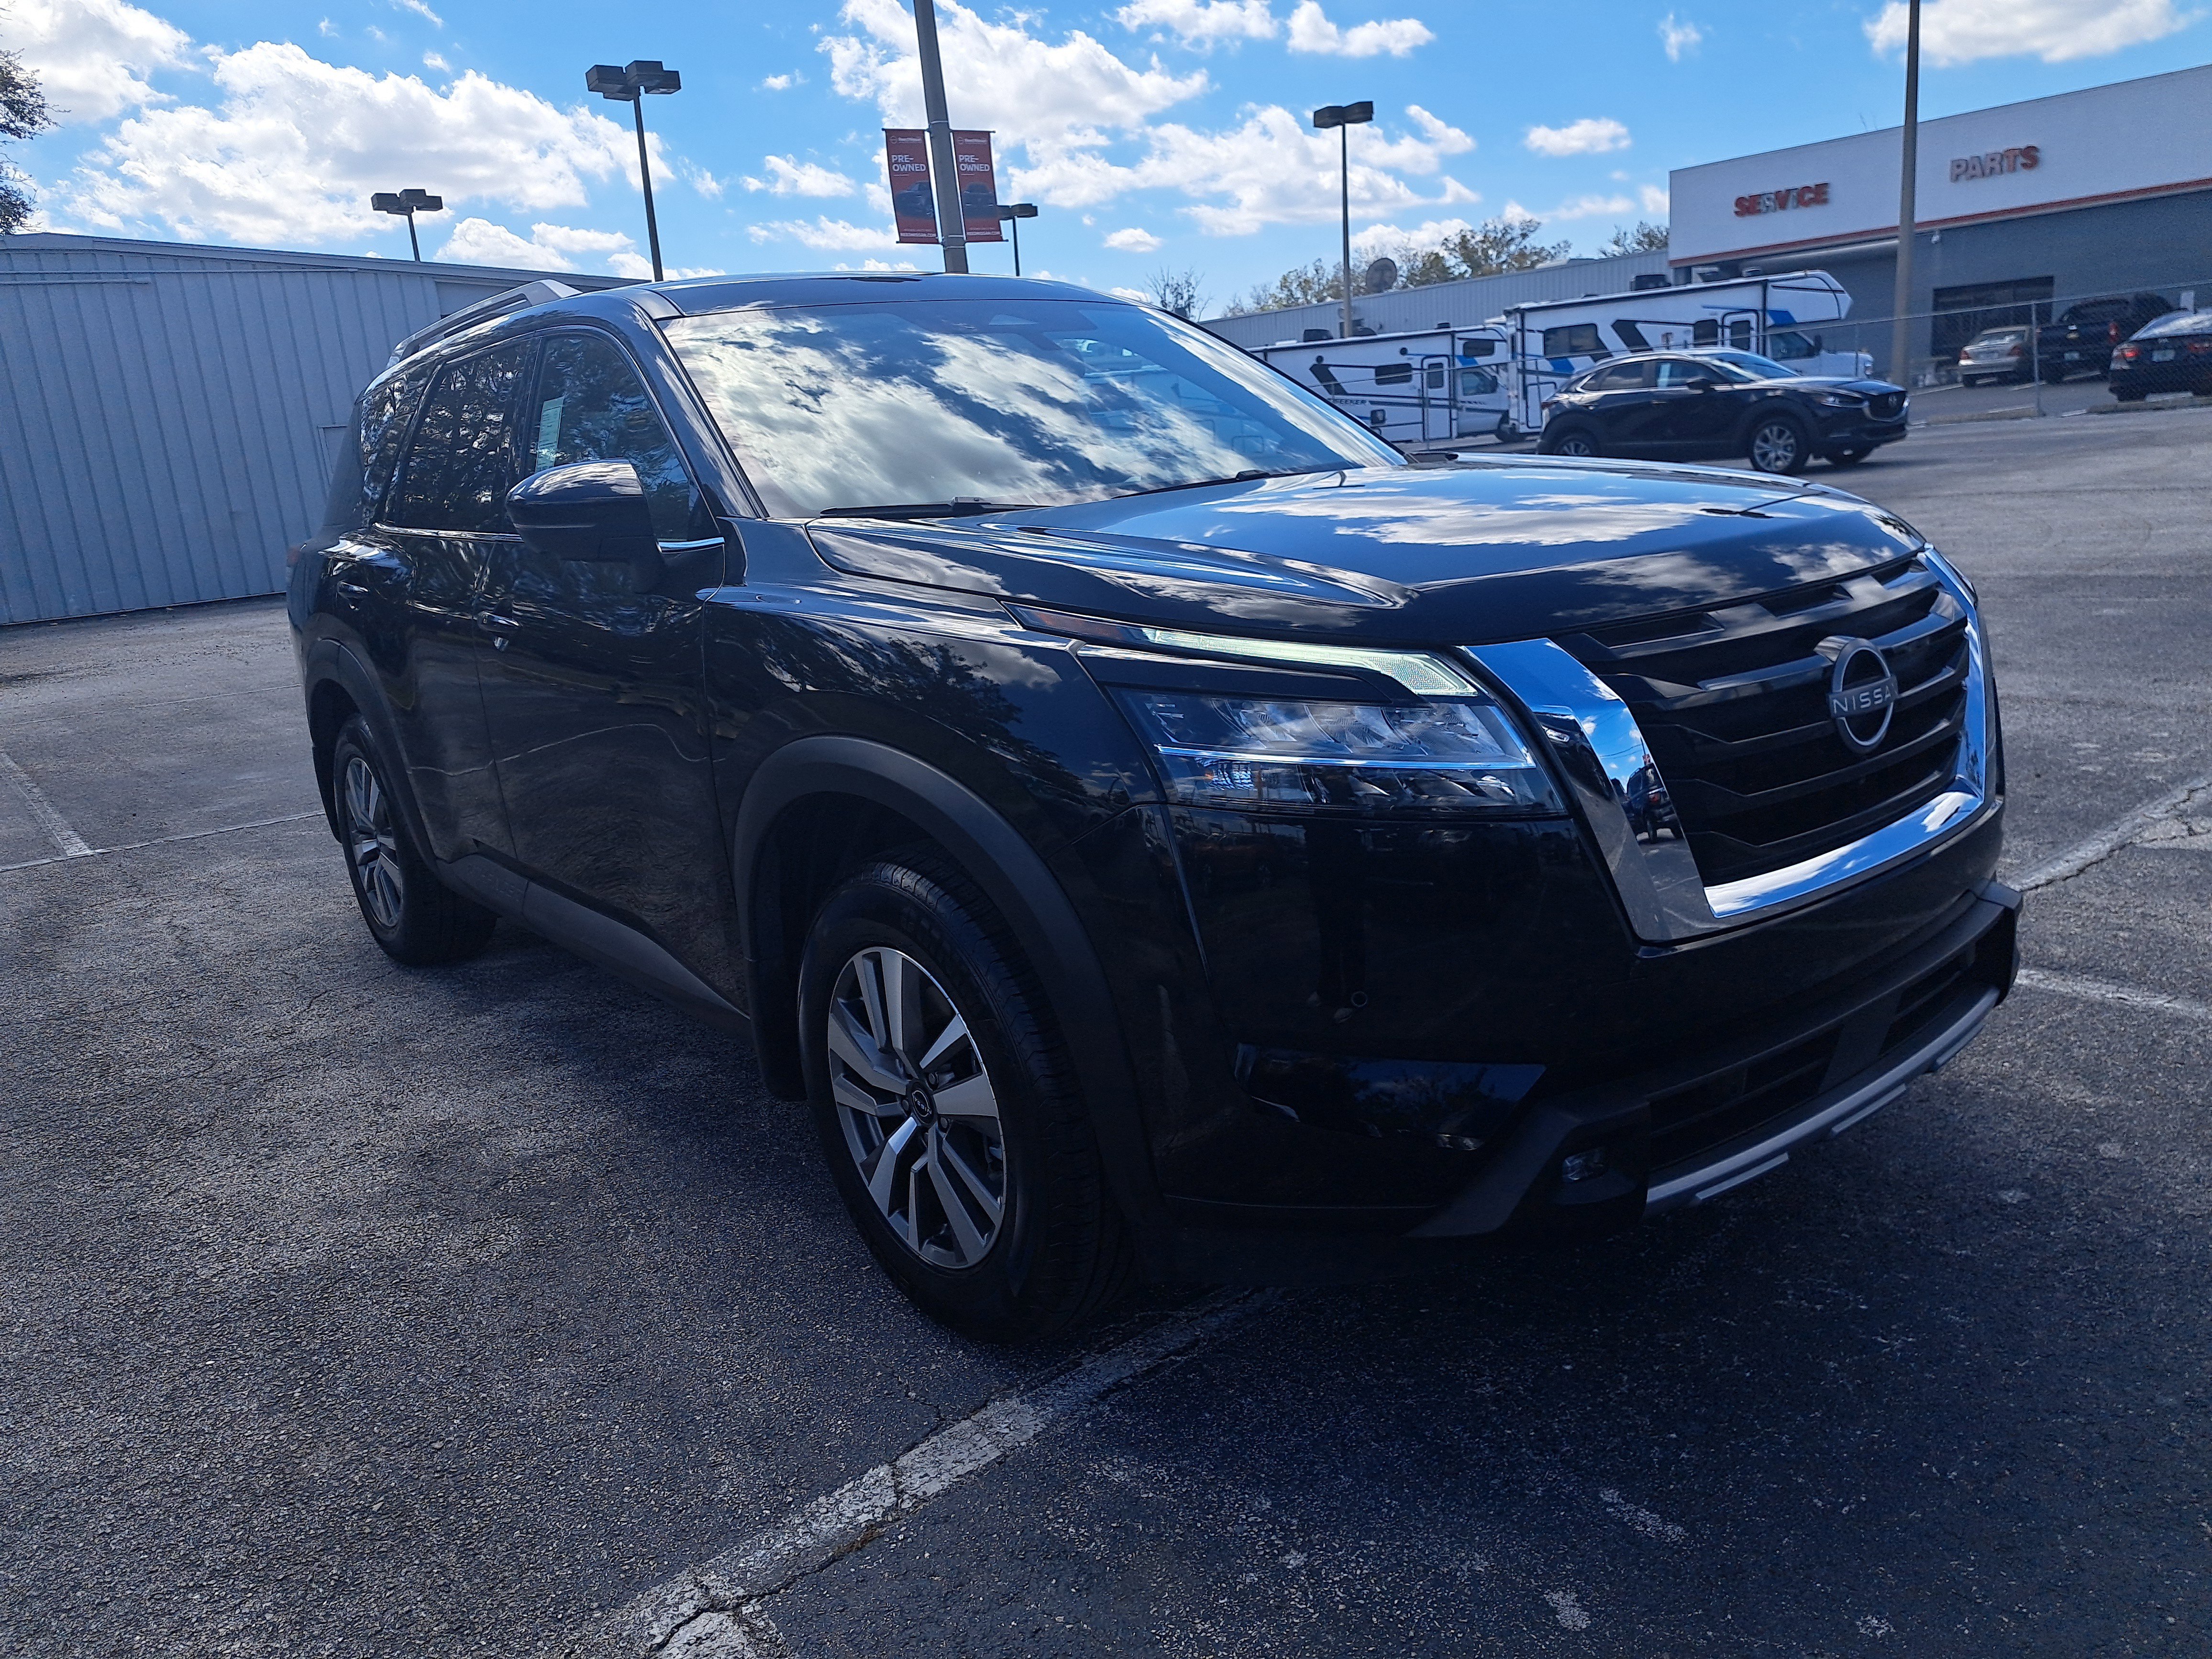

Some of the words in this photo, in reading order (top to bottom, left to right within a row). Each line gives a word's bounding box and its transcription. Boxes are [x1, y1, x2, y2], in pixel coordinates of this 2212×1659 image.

[892, 155, 914, 163] PRE-
[958, 155, 979, 163] PRE-
[892, 163, 927, 172] OWNED
[959, 163, 990, 172] OWNED
[1950, 146, 2040, 182] PARTS
[1734, 183, 1829, 217] SERVICE
